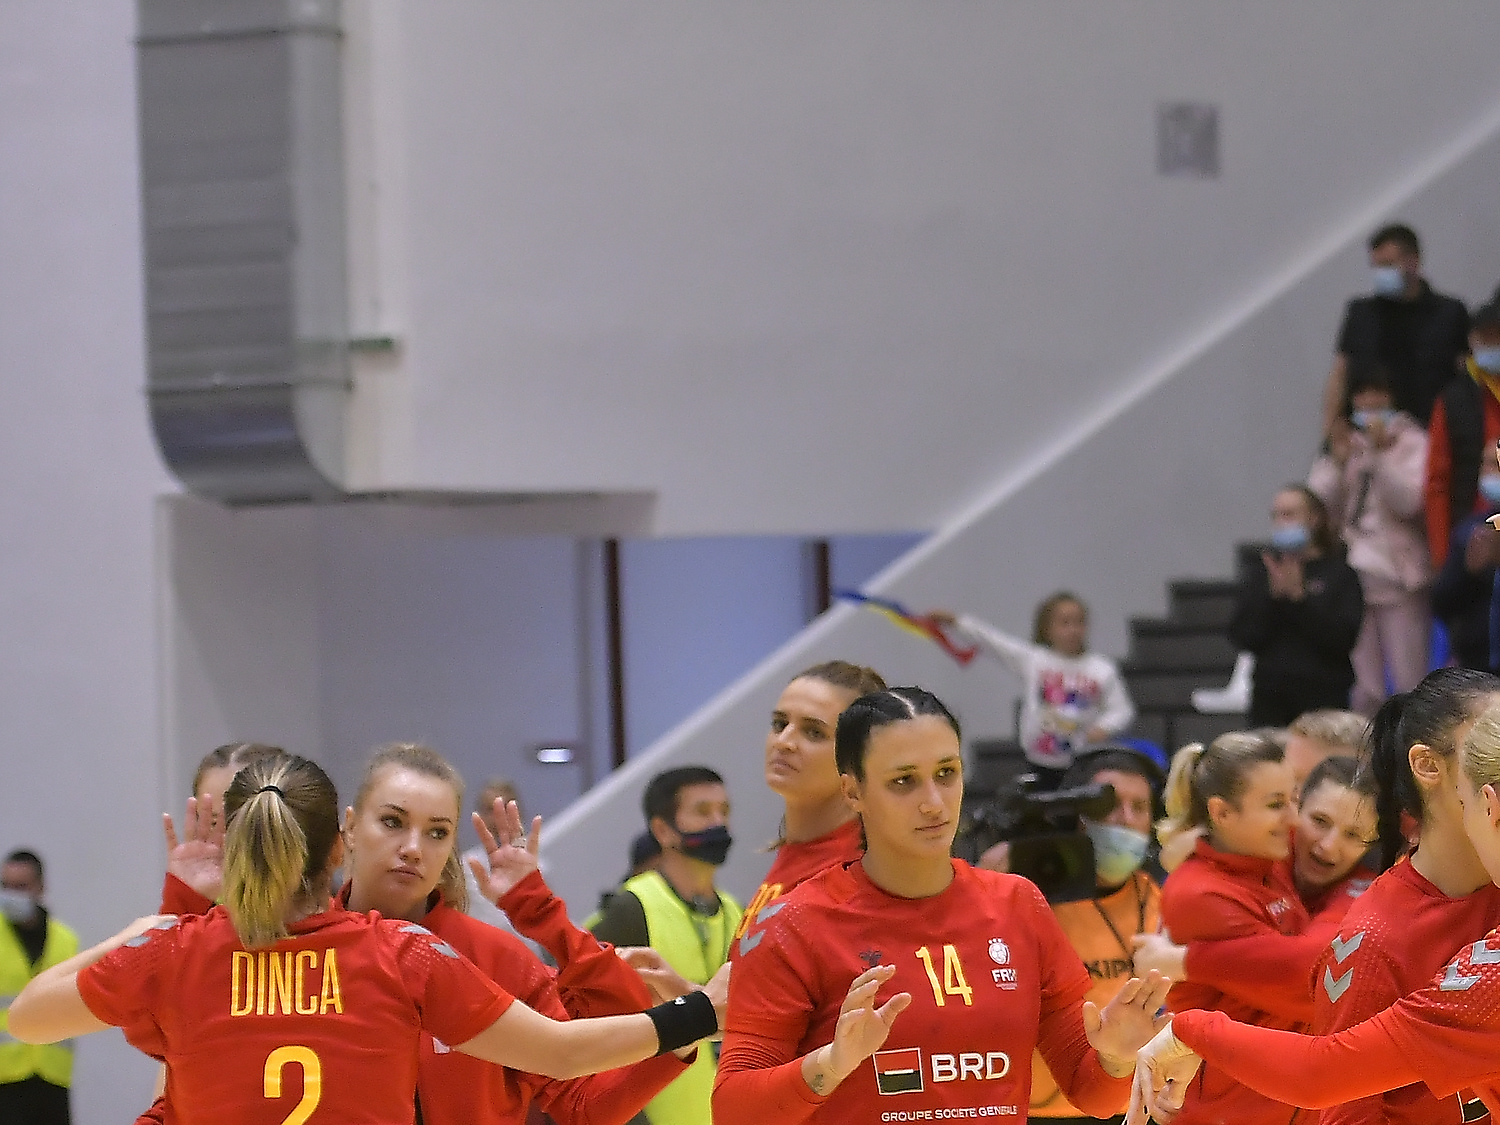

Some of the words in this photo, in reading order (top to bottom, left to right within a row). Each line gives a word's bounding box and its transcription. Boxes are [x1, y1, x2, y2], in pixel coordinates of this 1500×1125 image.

[230, 948, 344, 1018] DINCA
[914, 944, 973, 1007] 14
[930, 1051, 1011, 1083] BRD
[881, 1110, 933, 1123] GROUPE
[934, 1106, 977, 1119] SOCIETE
